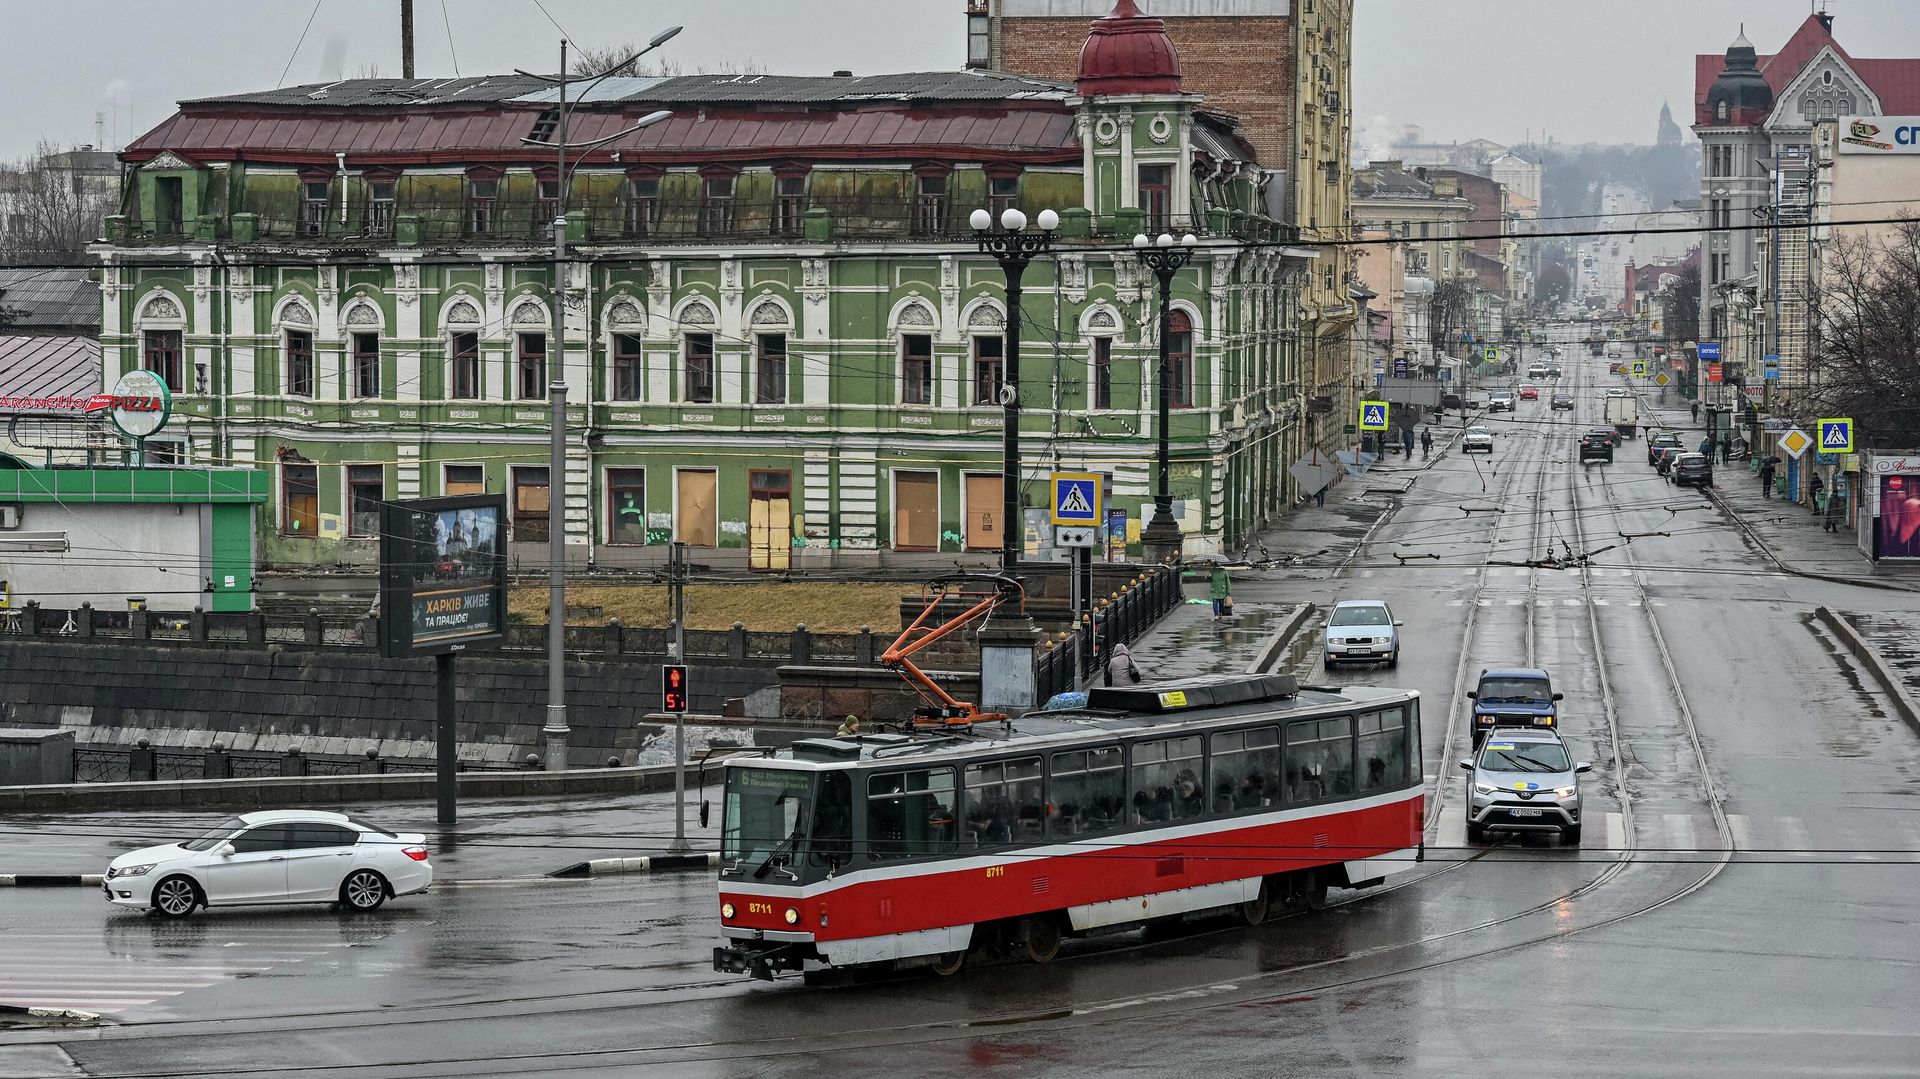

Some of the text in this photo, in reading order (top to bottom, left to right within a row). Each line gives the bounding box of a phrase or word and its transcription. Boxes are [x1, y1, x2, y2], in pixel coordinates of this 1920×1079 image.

[111, 396, 163, 412] PIZZA
[426, 593, 490, 614] ХАРКІВ ЖИВЕ
[425, 612, 469, 627] ТА ПРАЦЮЄ!
[742, 771, 749, 785] 6
[986, 866, 1004, 878] 8711
[749, 902, 772, 914] 8711
